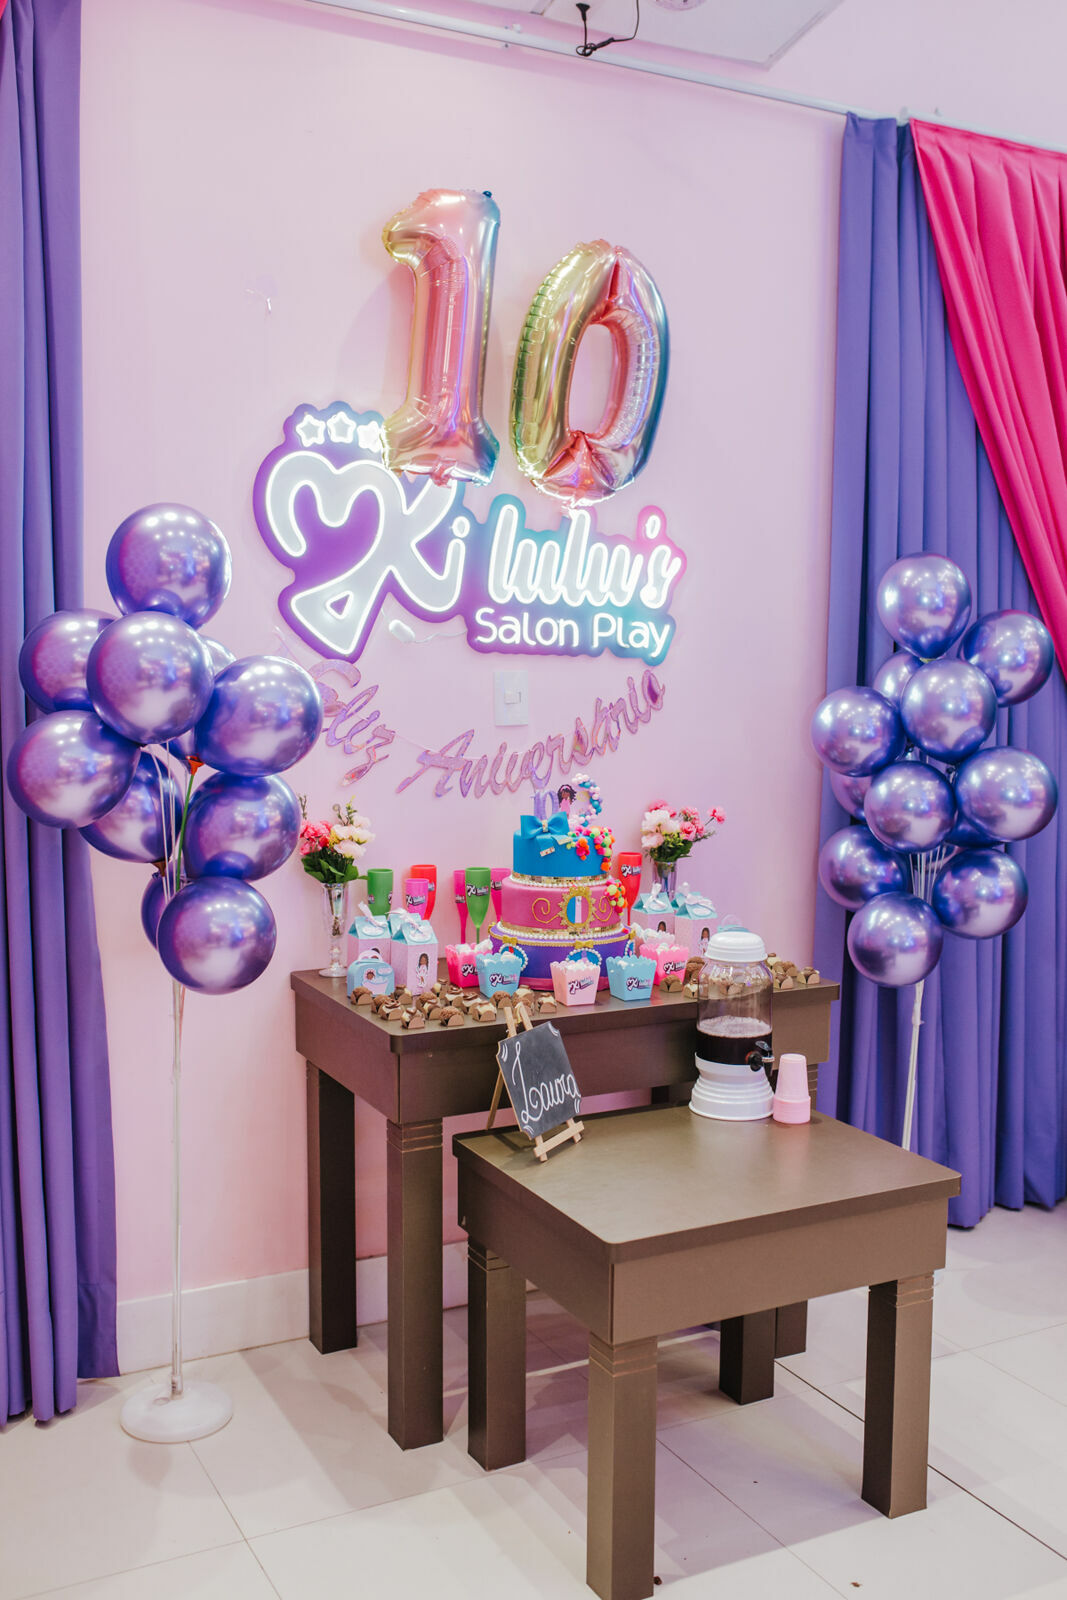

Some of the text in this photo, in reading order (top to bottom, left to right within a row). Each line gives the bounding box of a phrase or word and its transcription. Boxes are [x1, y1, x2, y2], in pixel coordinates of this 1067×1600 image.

[382, 188, 670, 511] 10
[475, 607, 670, 658] Salon Play
[511, 1041, 581, 1124] Laura
